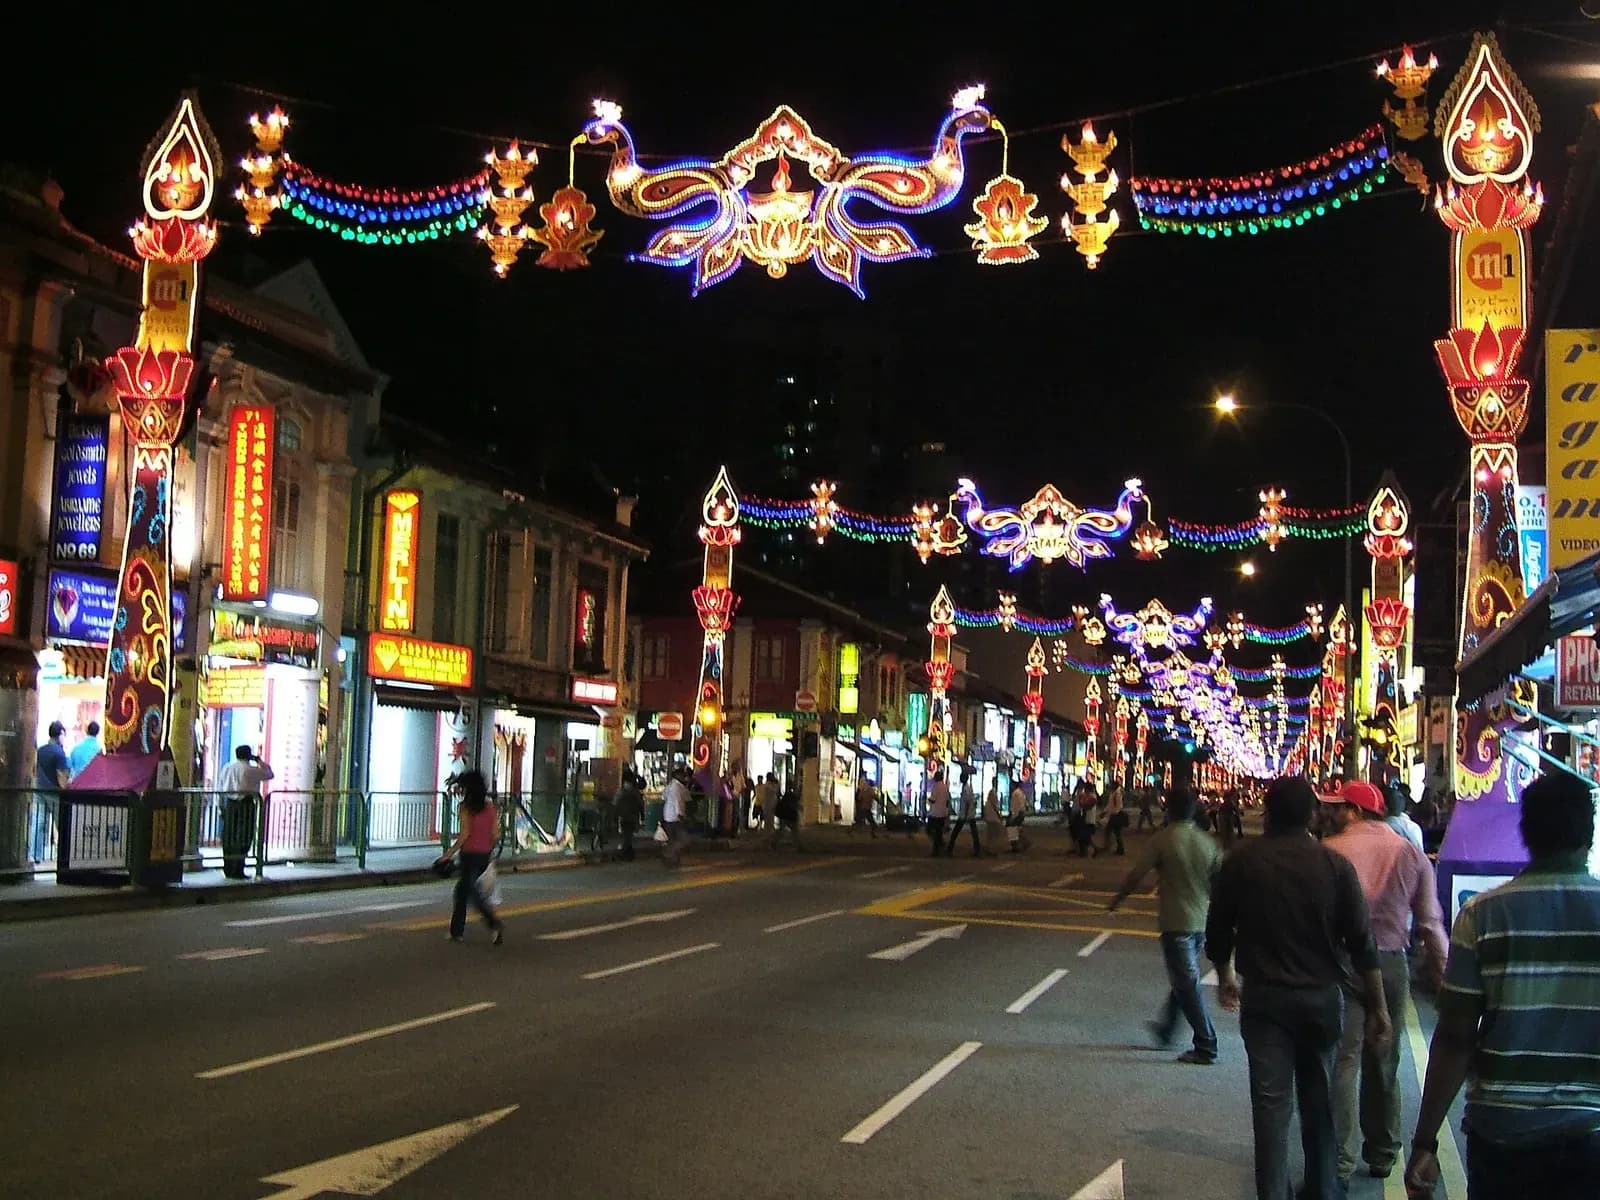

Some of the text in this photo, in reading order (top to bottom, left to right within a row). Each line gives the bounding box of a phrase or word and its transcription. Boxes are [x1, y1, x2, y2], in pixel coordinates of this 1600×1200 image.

[1471, 253, 1516, 278] m1
[78, 543, 97, 560] 69
[389, 511, 413, 618] MERLIN
